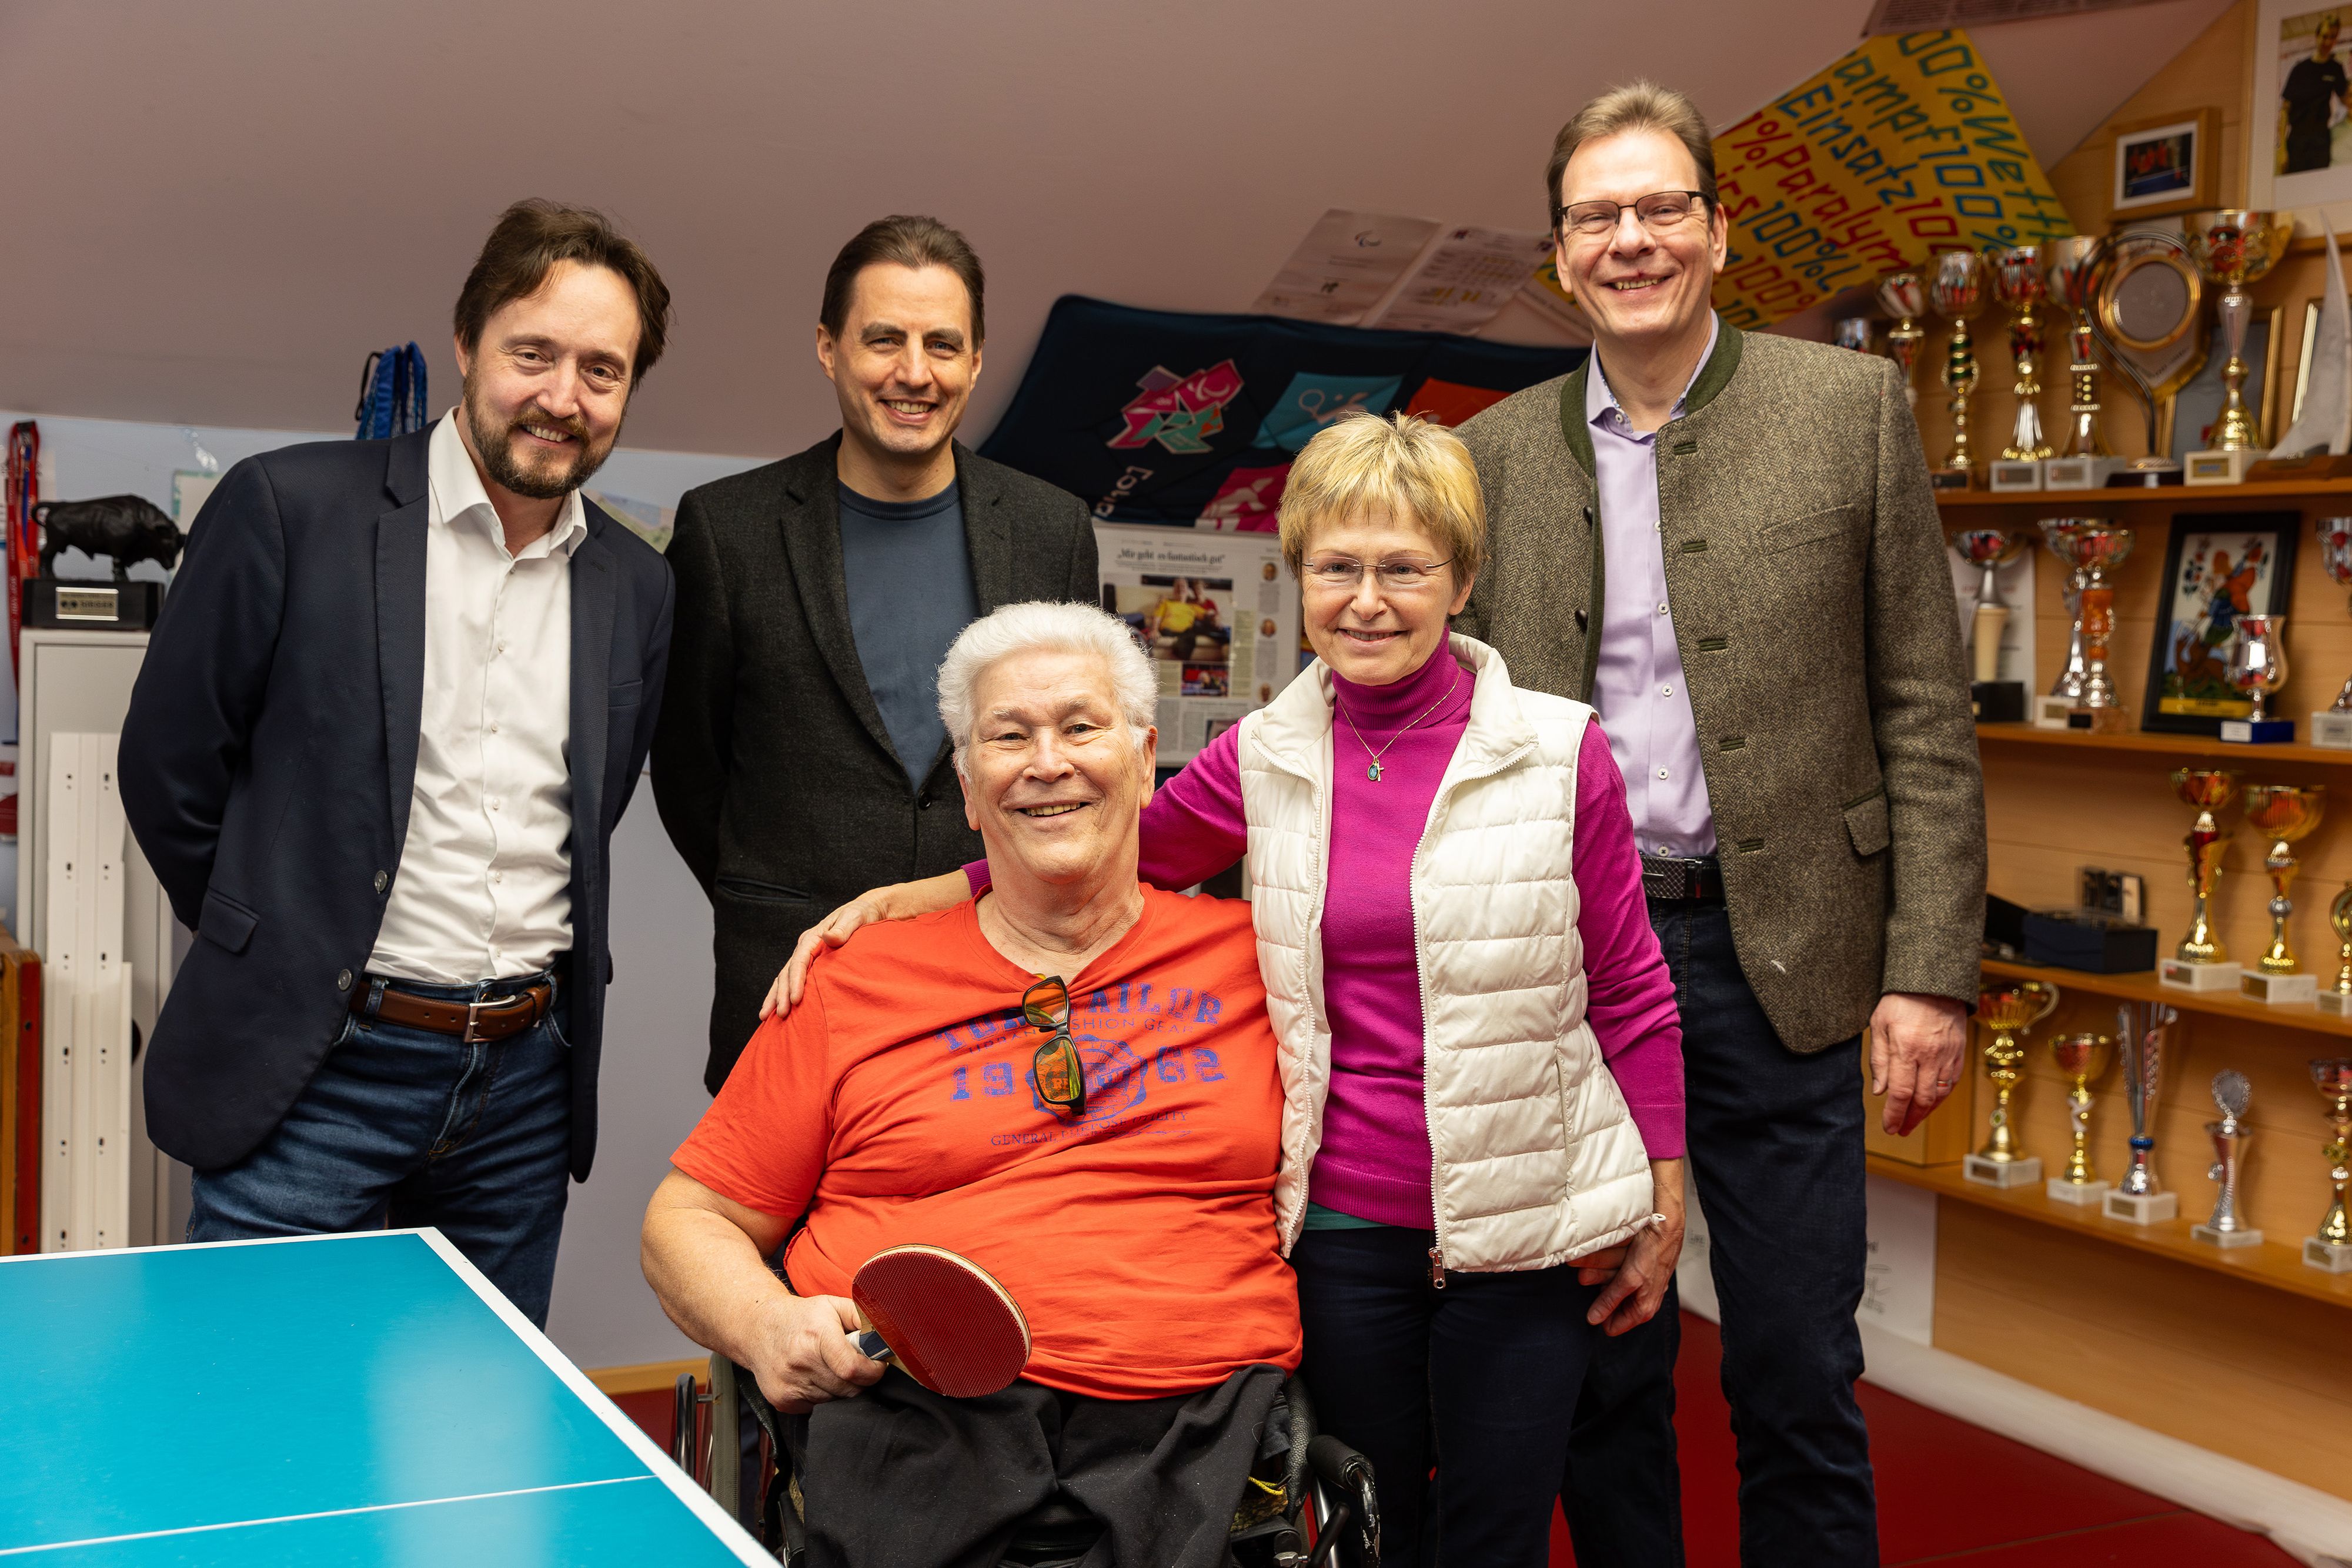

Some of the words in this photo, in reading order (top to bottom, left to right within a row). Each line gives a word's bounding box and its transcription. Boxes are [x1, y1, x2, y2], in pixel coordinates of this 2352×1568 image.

[1070, 981, 1224, 1026] AILOR
[1144, 1018, 1194, 1034] GEAR
[991, 1132, 1058, 1146] GENERAL
